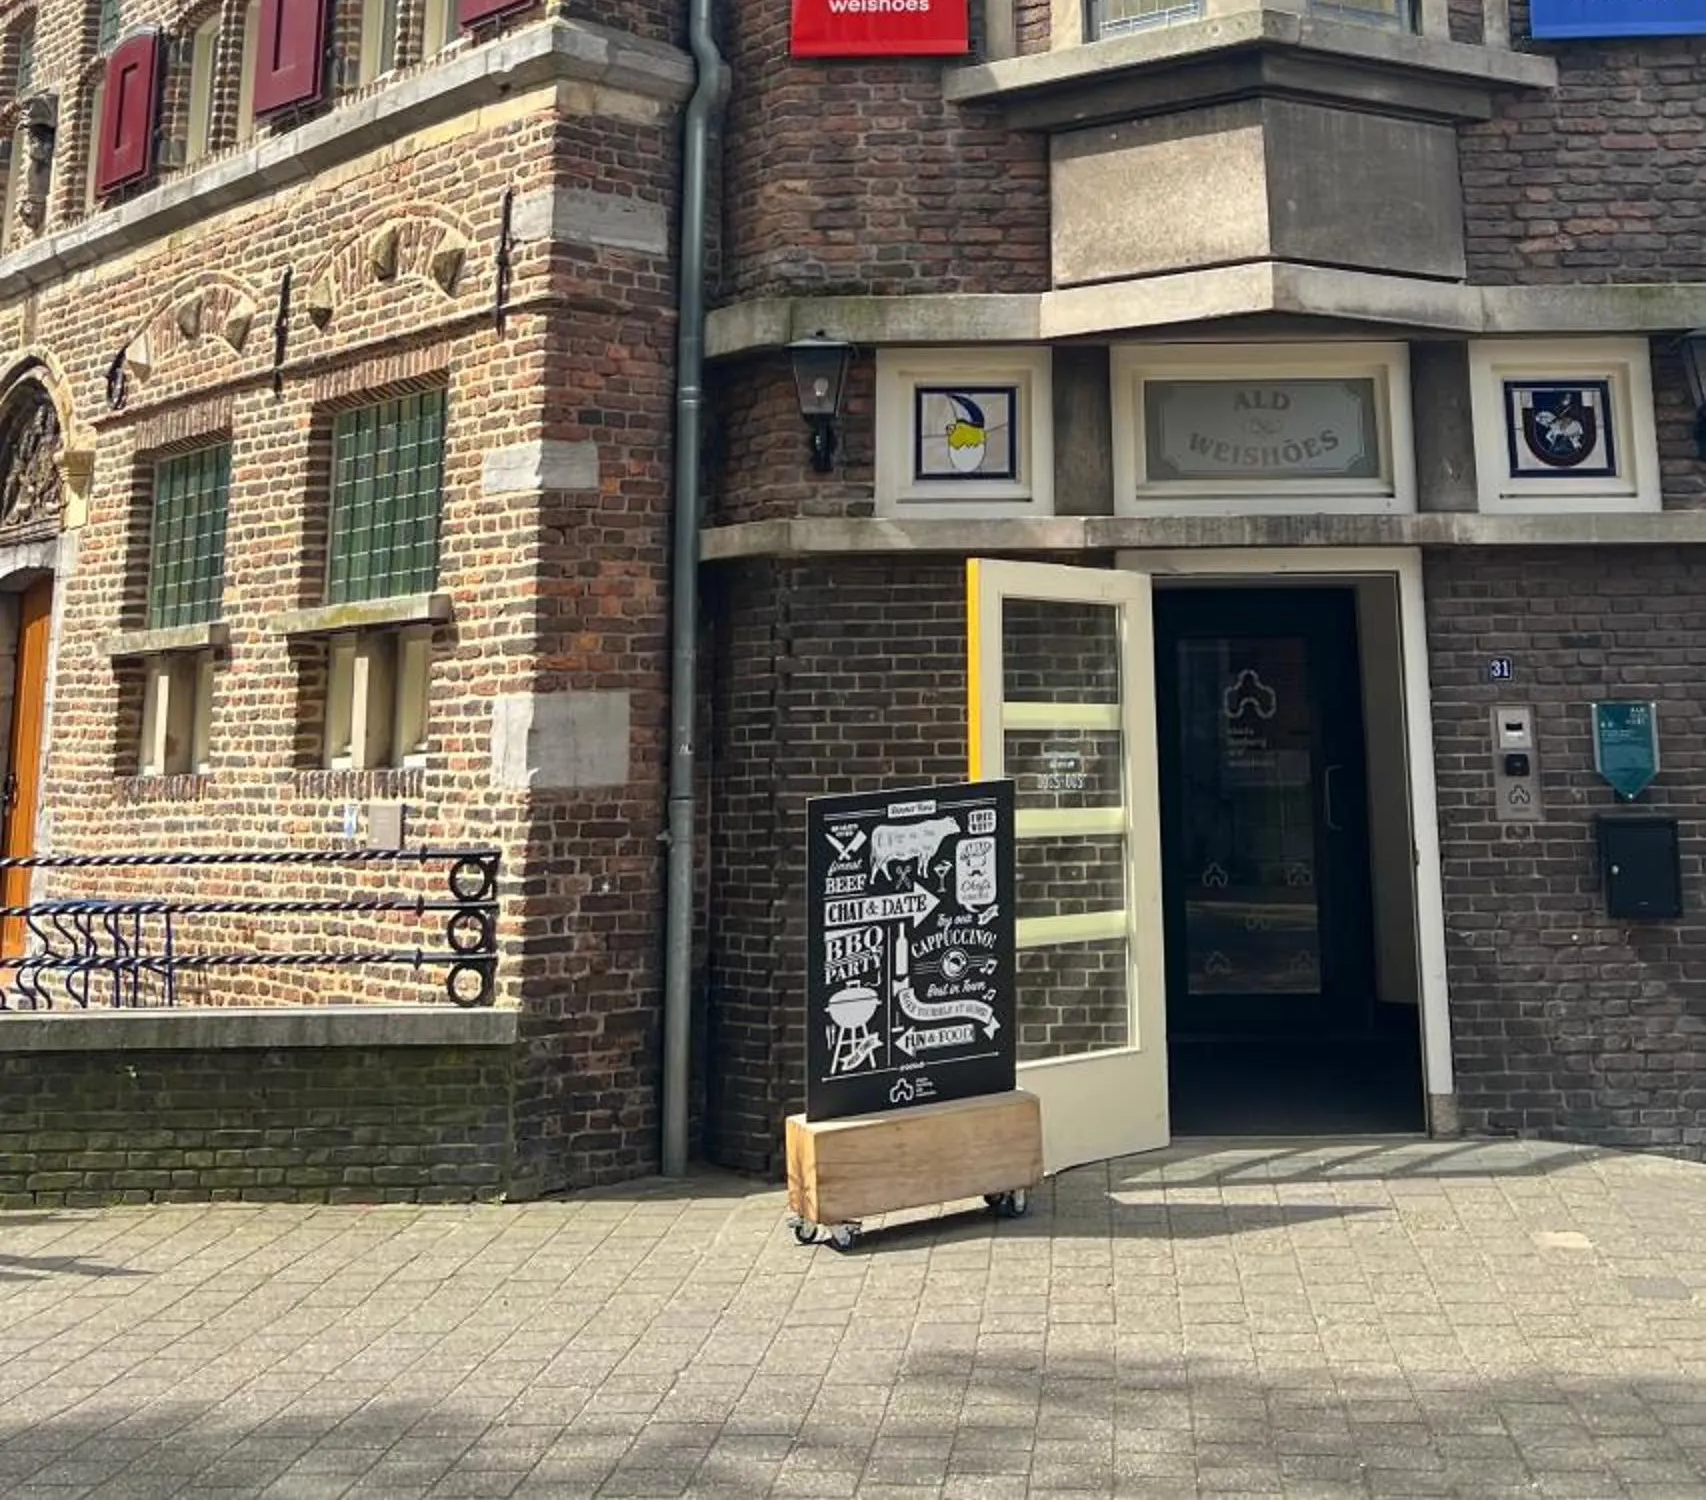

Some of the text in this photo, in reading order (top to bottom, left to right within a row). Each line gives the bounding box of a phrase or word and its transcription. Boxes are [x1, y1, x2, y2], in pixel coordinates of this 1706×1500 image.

[1233, 389, 1291, 412] ALD
[1491, 660, 1509, 677] 31
[824, 874, 867, 895] BEEF
[828, 894, 927, 923] CHAT & DATE
[825, 925, 884, 963] BBQ
[824, 952, 882, 985] PARTY
[905, 1032, 926, 1049] FUN
